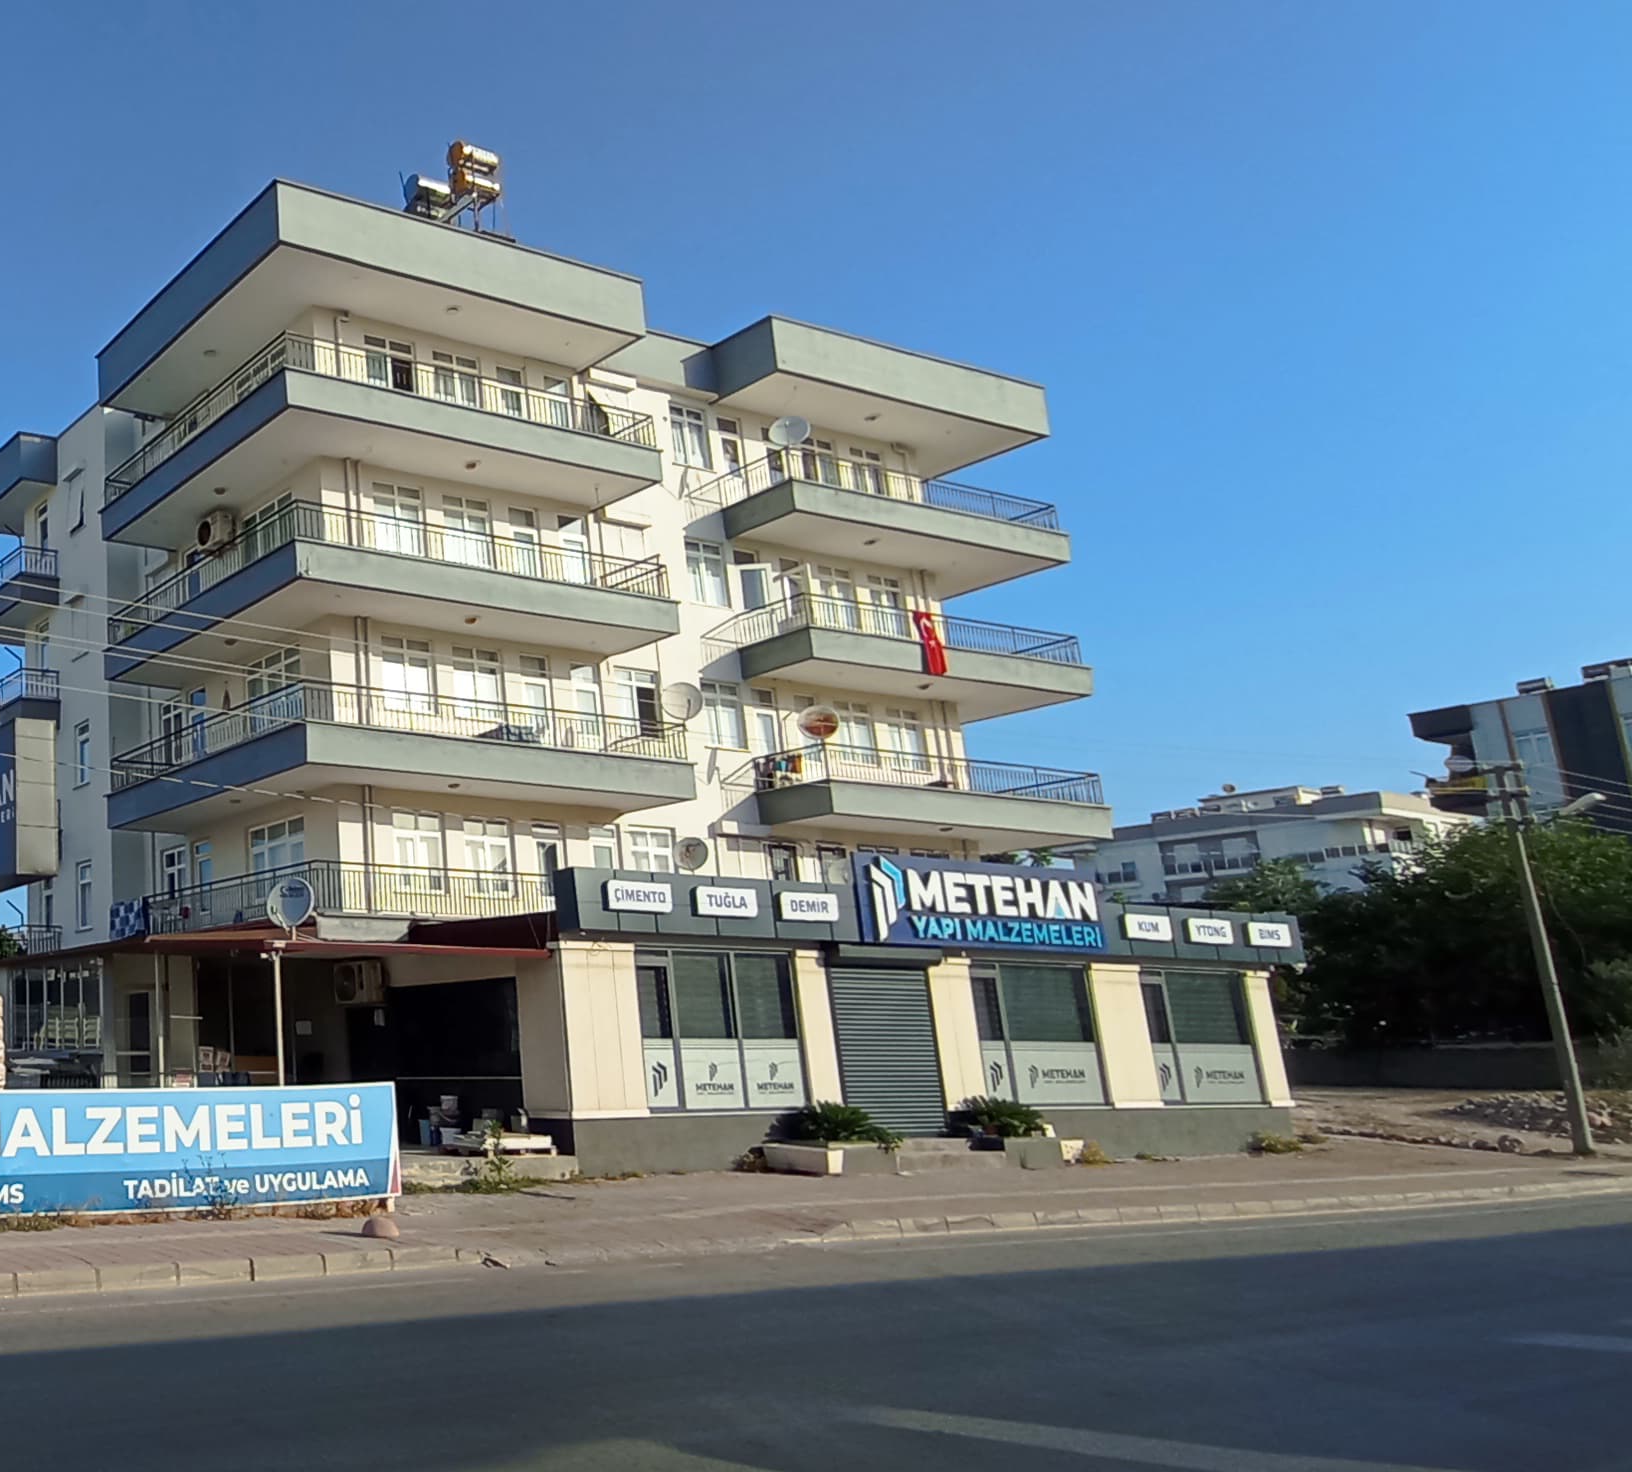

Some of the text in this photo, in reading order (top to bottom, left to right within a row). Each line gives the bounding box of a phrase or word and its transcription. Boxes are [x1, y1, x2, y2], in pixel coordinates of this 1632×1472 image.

[706, 892, 748, 909] TUĞLA
[906, 868, 1099, 922] METEHAN
[911, 915, 962, 941] YAPI
[1137, 921, 1160, 933] KUM
[1195, 925, 1227, 938] YTONG
[123, 1168, 370, 1199] TADİLAT ve UYGULAMA
